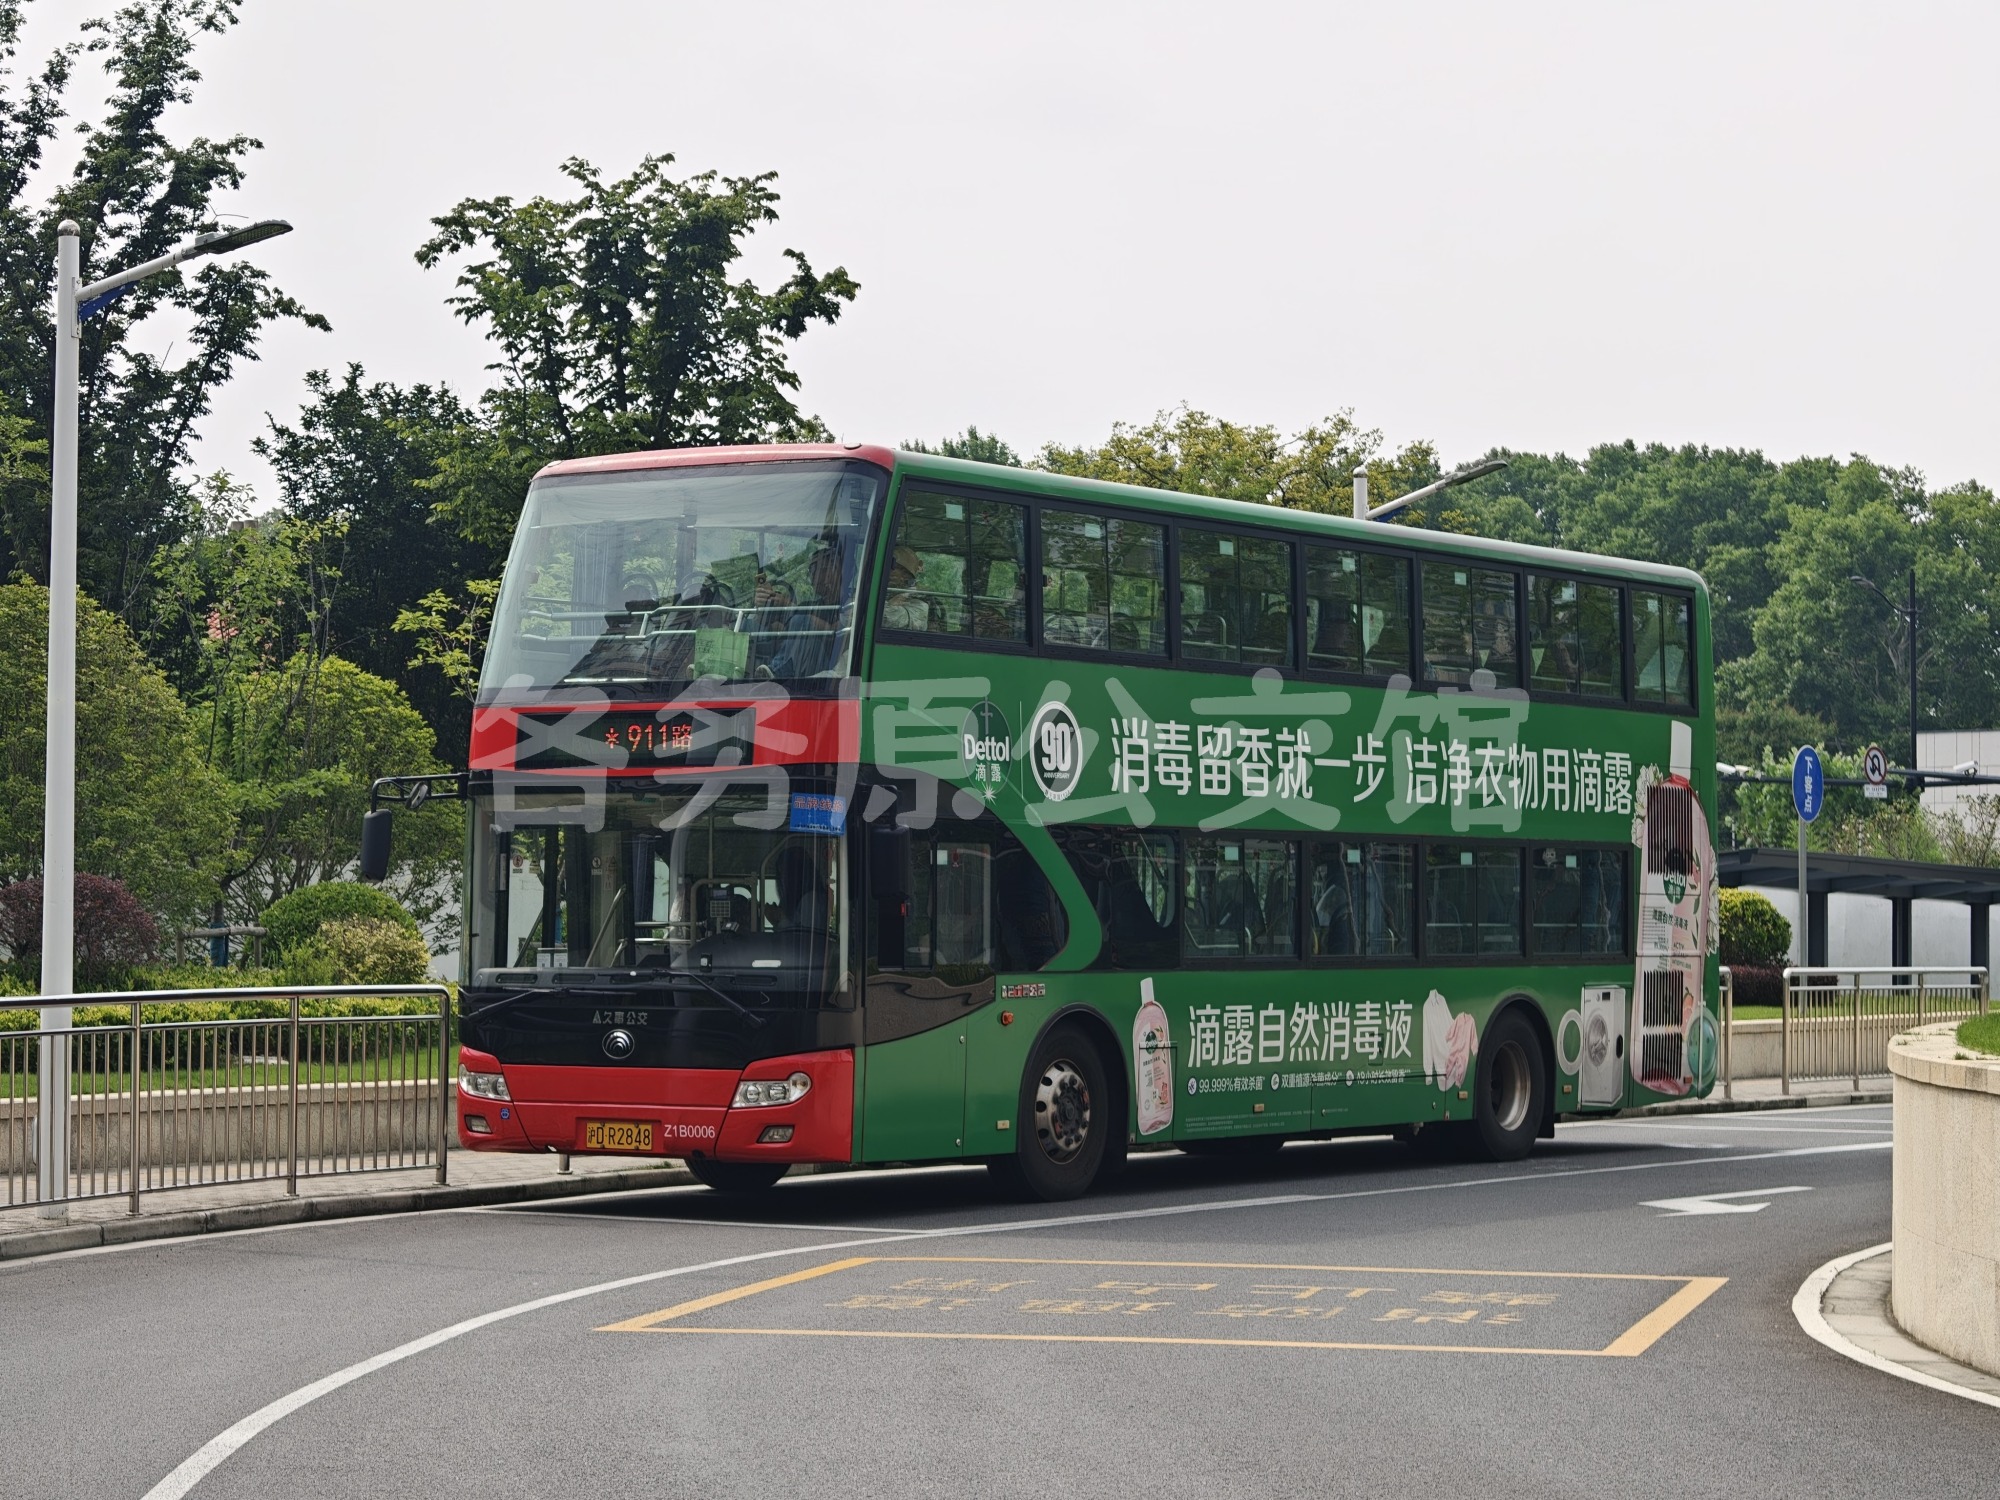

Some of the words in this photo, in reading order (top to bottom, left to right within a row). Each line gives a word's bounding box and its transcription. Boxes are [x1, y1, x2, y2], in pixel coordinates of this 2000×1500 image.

[963, 733, 1010, 762] Dettol
[1041, 721, 1071, 772] 90
[975, 763, 1002, 783] 滴露
[1043, 772, 1071, 780] ANNIVERSARY
[1111, 716, 1387, 802] 消毒留香就一步
[1404, 736, 1634, 816] 洁净衣物用滴露
[1187, 999, 1413, 1068] 滴露自然消毒液
[664, 1124, 716, 1139] Z1B0006
